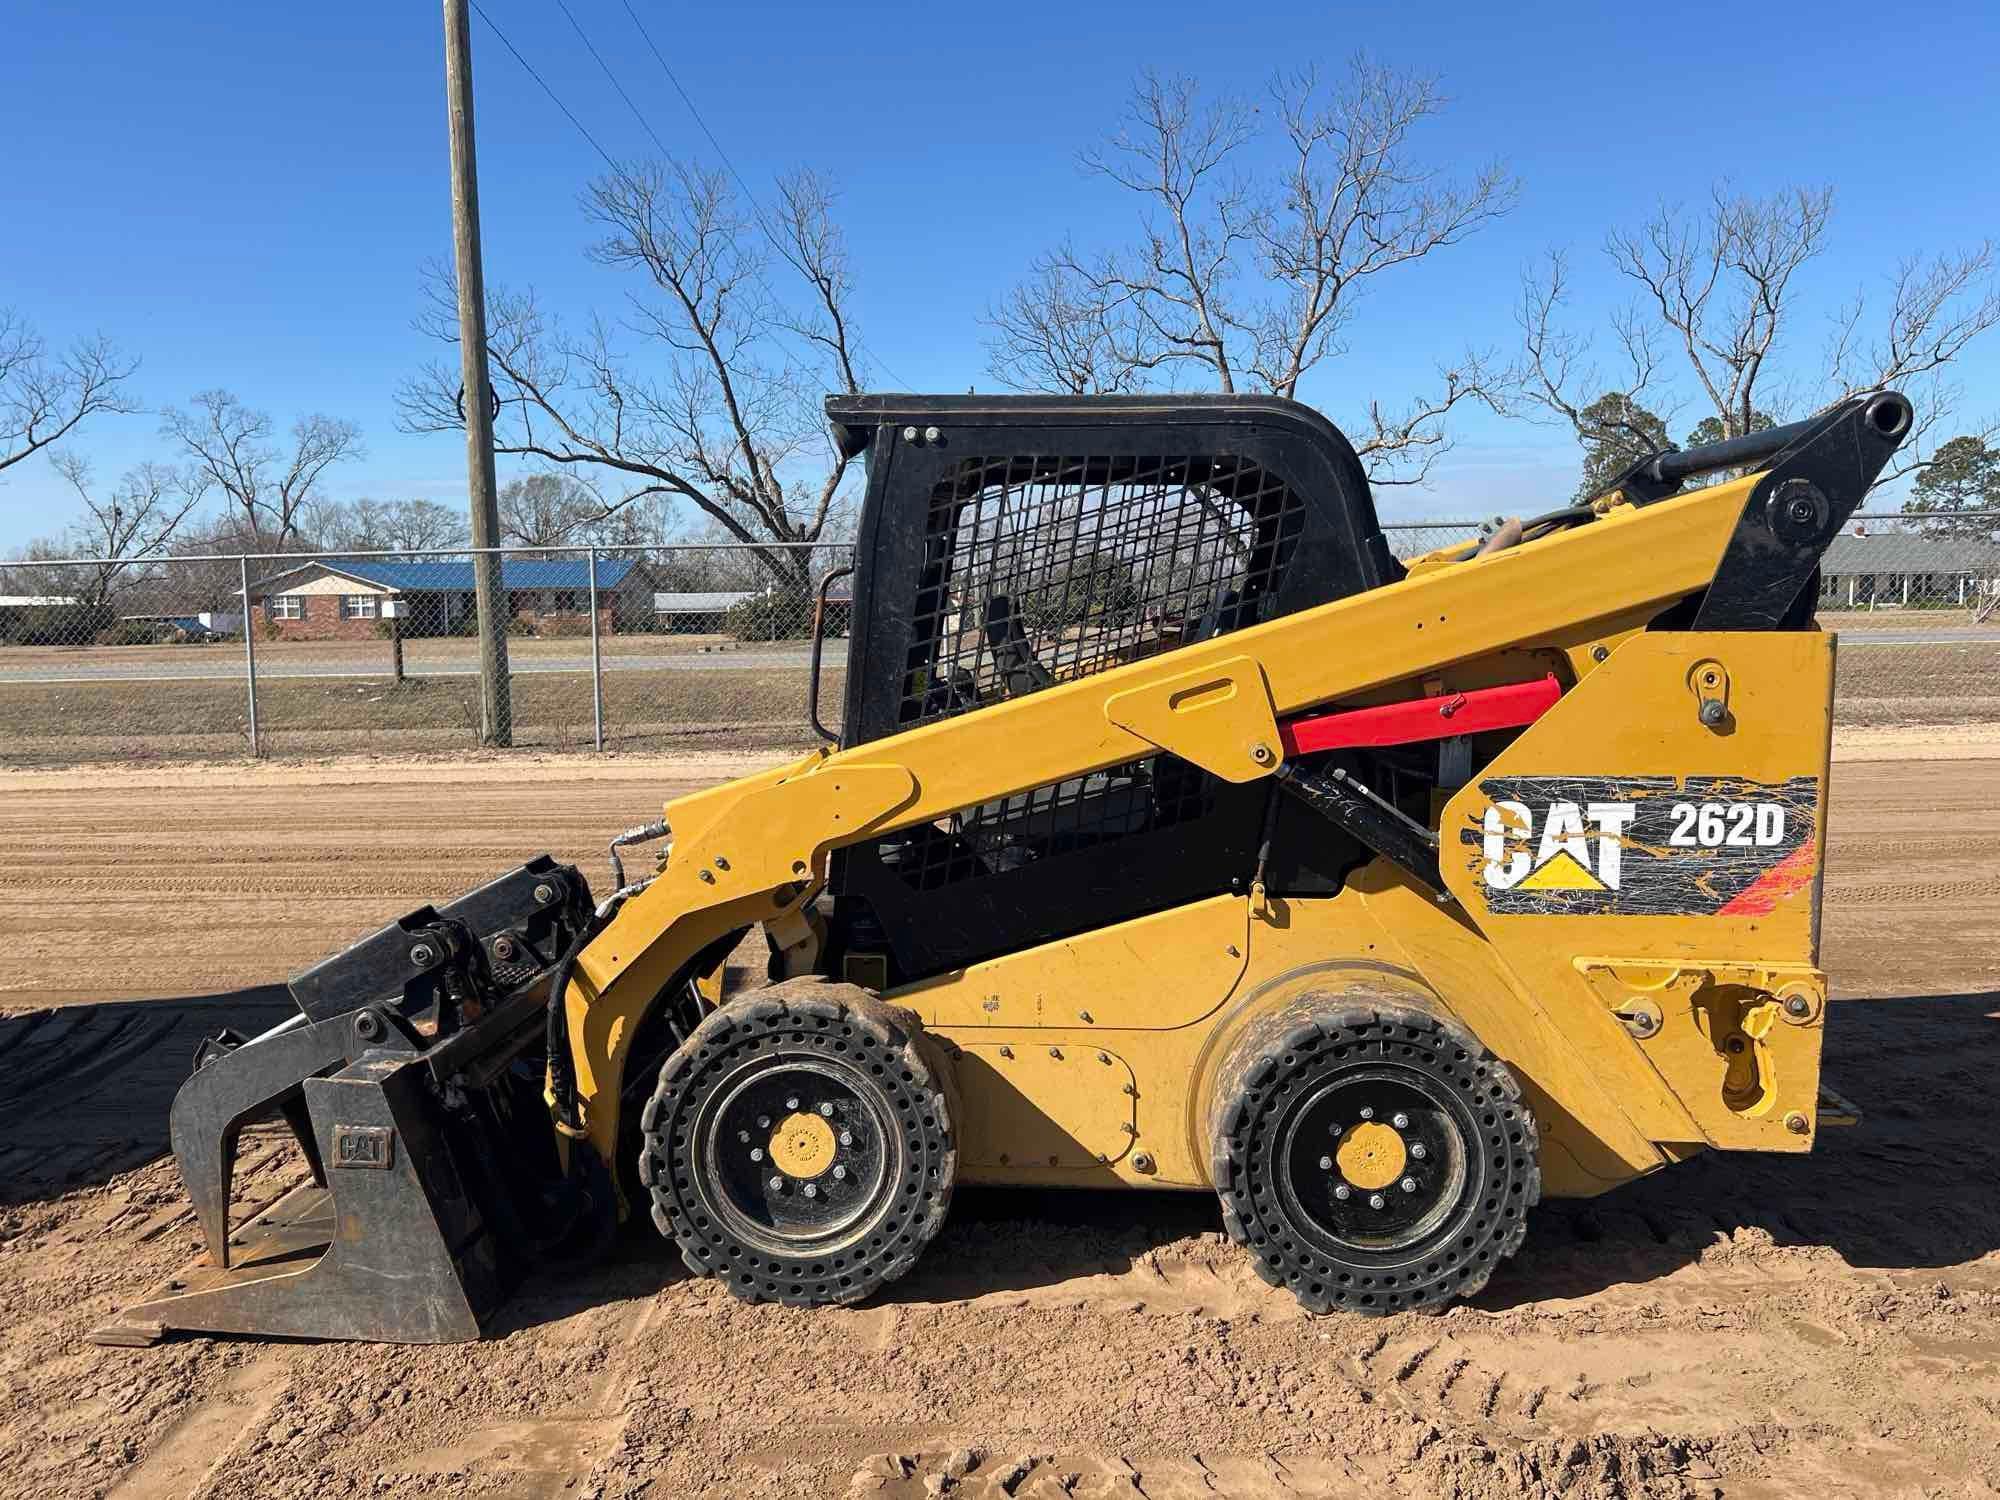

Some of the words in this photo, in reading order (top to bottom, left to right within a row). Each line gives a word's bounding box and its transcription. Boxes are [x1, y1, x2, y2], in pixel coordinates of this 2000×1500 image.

[1483, 801, 1637, 890] CAT
[1669, 803, 1785, 847] 262D
[341, 1134, 385, 1162] CAT
